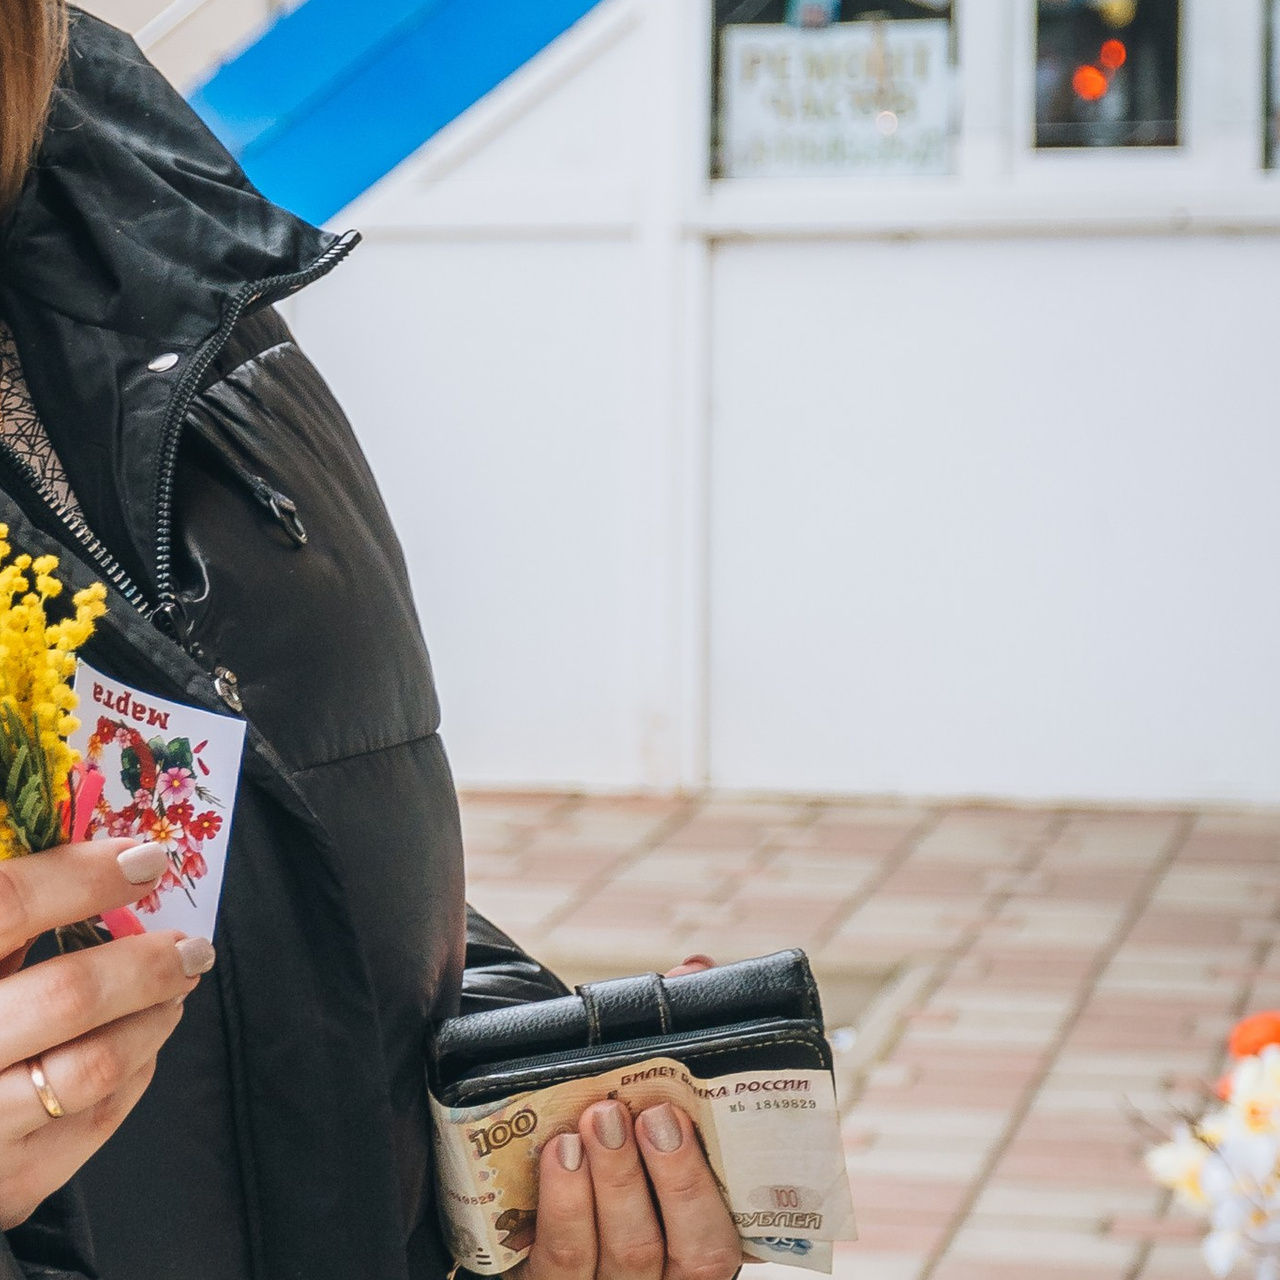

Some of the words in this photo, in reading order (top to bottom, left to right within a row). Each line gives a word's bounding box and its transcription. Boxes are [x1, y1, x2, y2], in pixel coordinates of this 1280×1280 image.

[92, 681, 170, 731] марта
[621, 1066, 675, 1085] БИЛЕТ
[678, 1072, 727, 1098] БНКА
[734, 1079, 810, 1094] РОССИИ
[755, 1100, 817, 1111] 1849829
[469, 1109, 538, 1157] 100
[774, 1189, 798, 1208] 100
